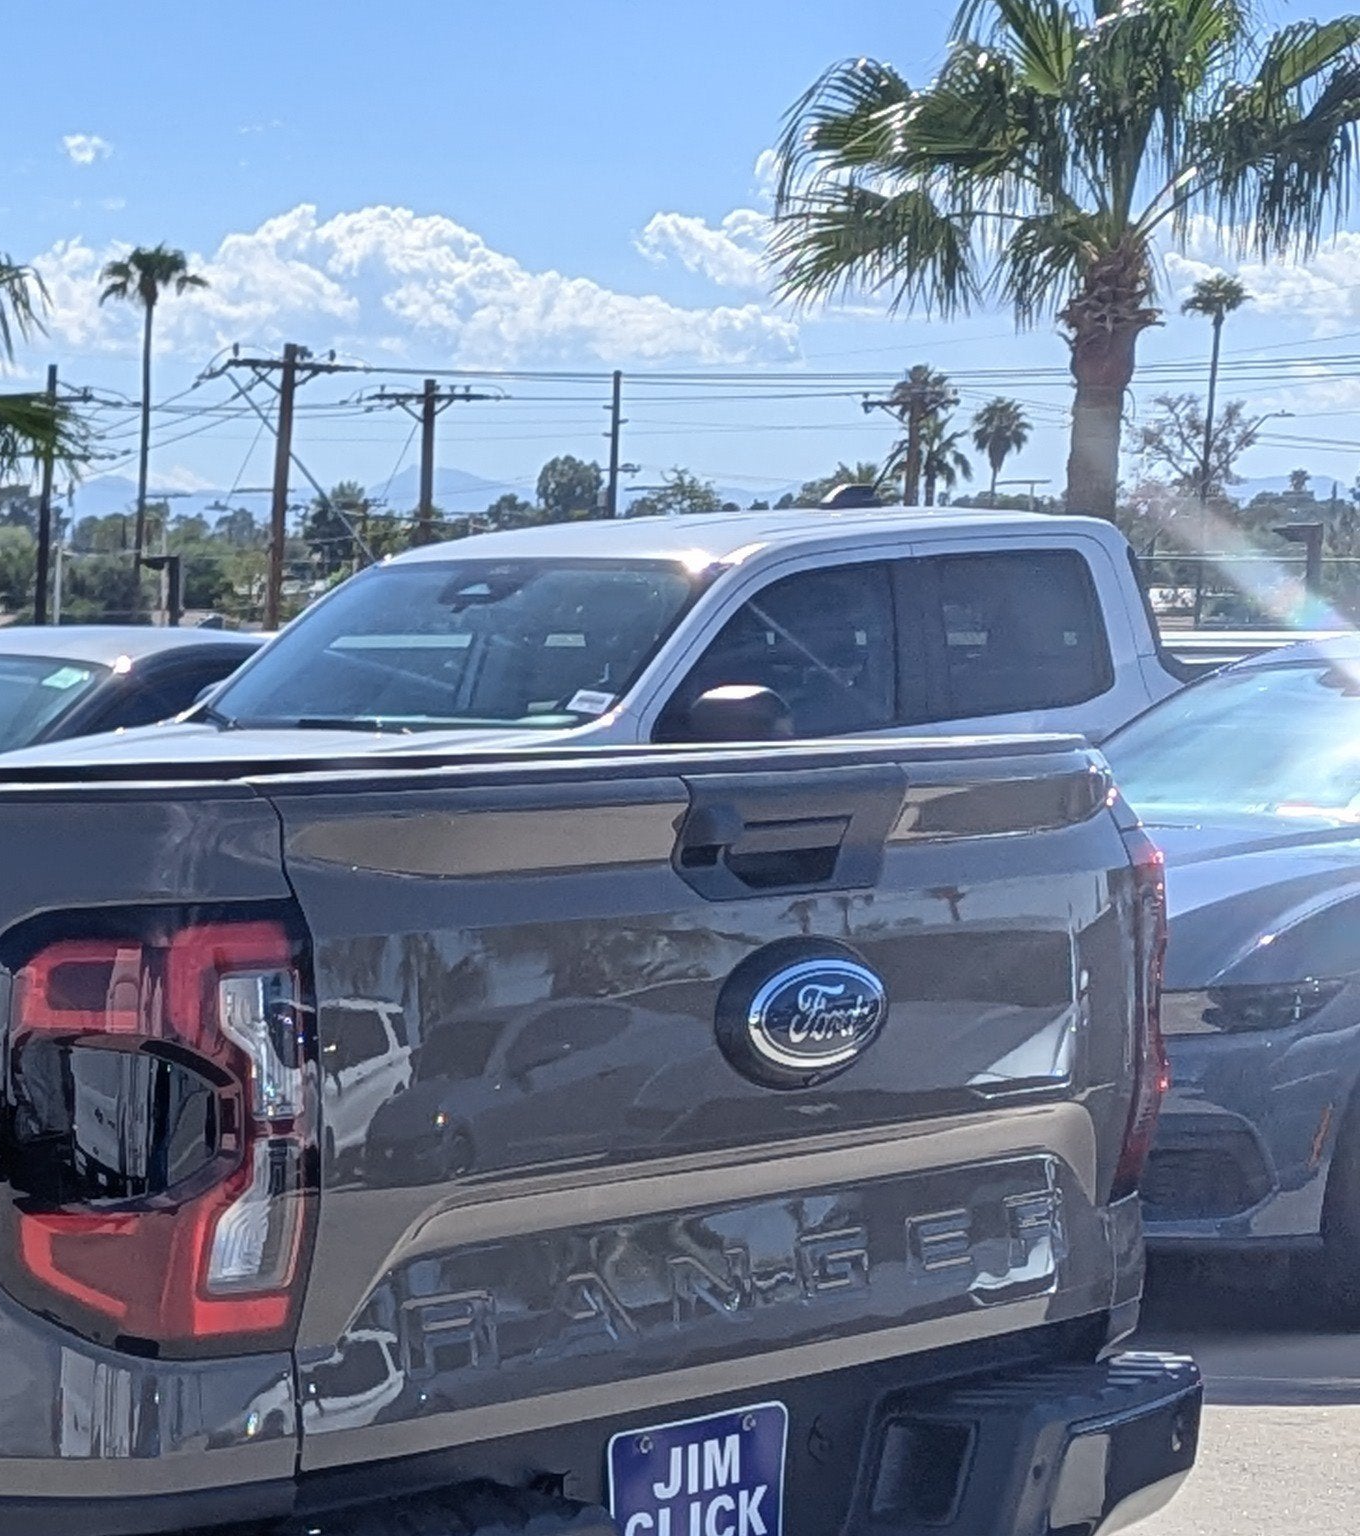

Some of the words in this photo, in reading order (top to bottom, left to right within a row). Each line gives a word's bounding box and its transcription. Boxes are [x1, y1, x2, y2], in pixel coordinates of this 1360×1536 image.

[789, 984, 873, 1043] Ford
[400, 1187, 1066, 1380] RANGER
[653, 1433, 740, 1500] JIM
